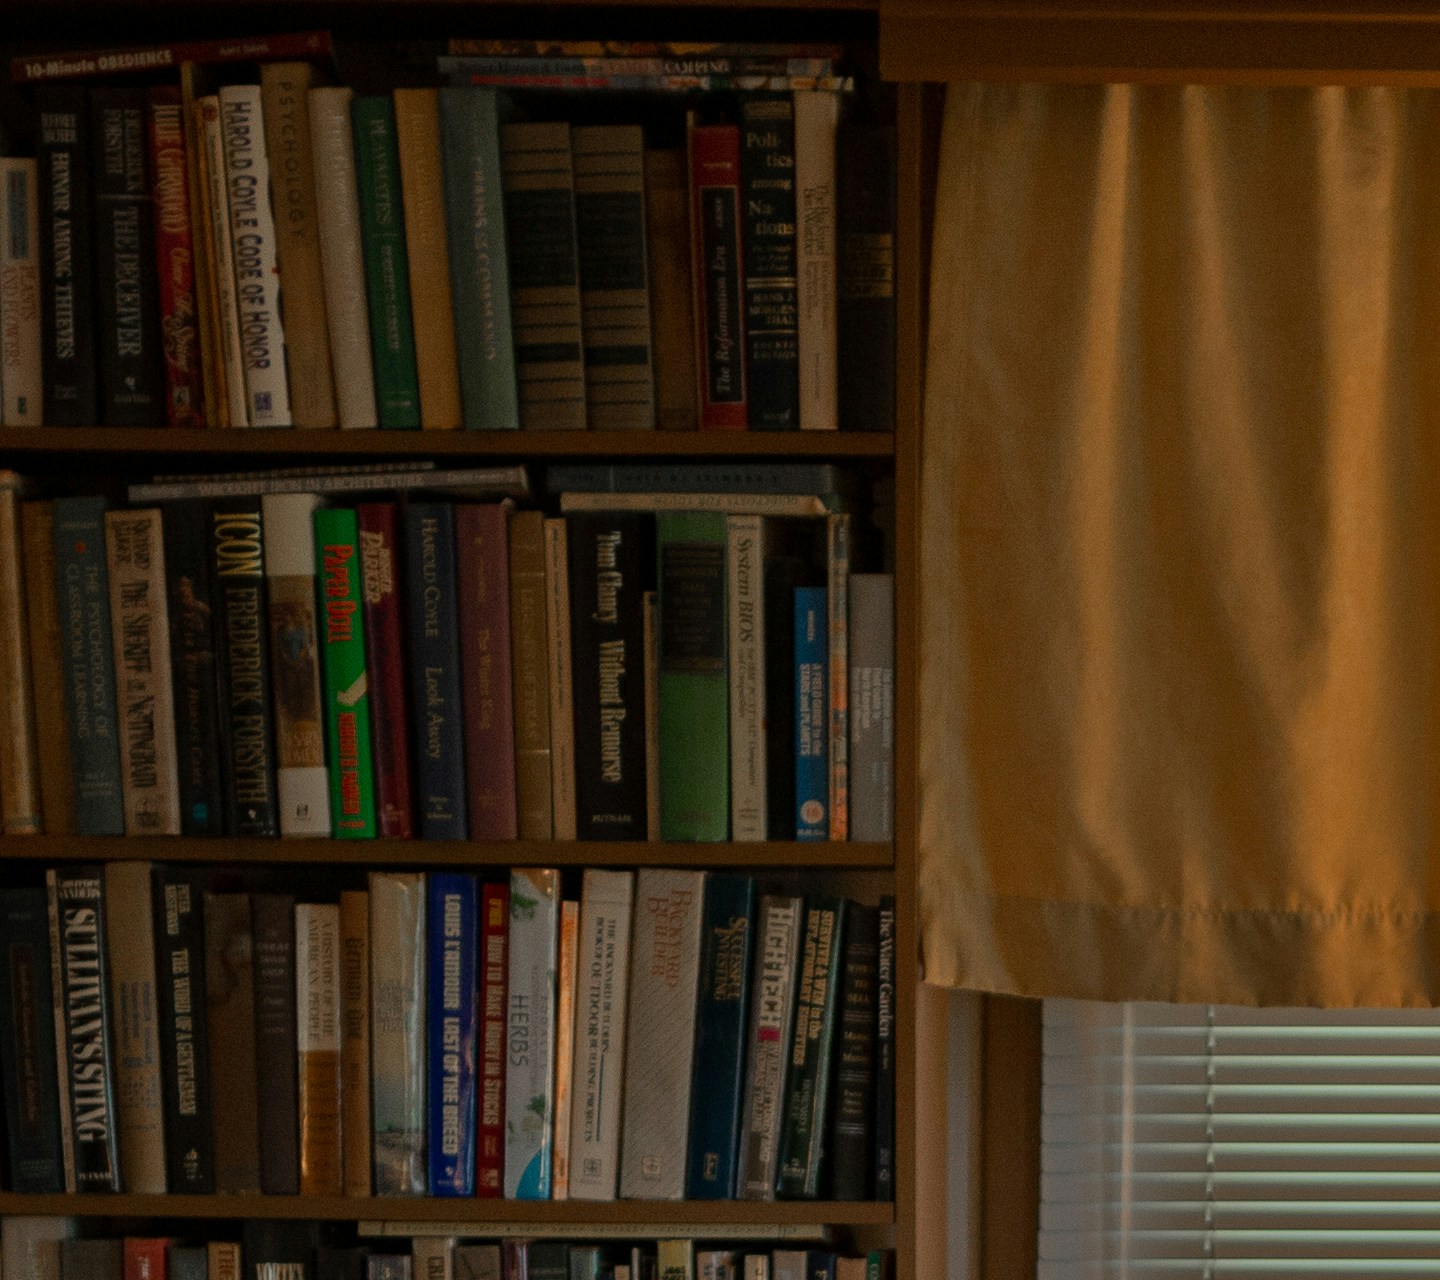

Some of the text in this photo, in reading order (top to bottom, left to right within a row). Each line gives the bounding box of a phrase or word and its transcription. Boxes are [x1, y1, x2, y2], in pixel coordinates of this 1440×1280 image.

[225, 102, 271, 370] HAROLD COYLE CODE OF HONOR
[214, 511, 263, 577] ICON
[512, 995, 529, 1066] HERBS
